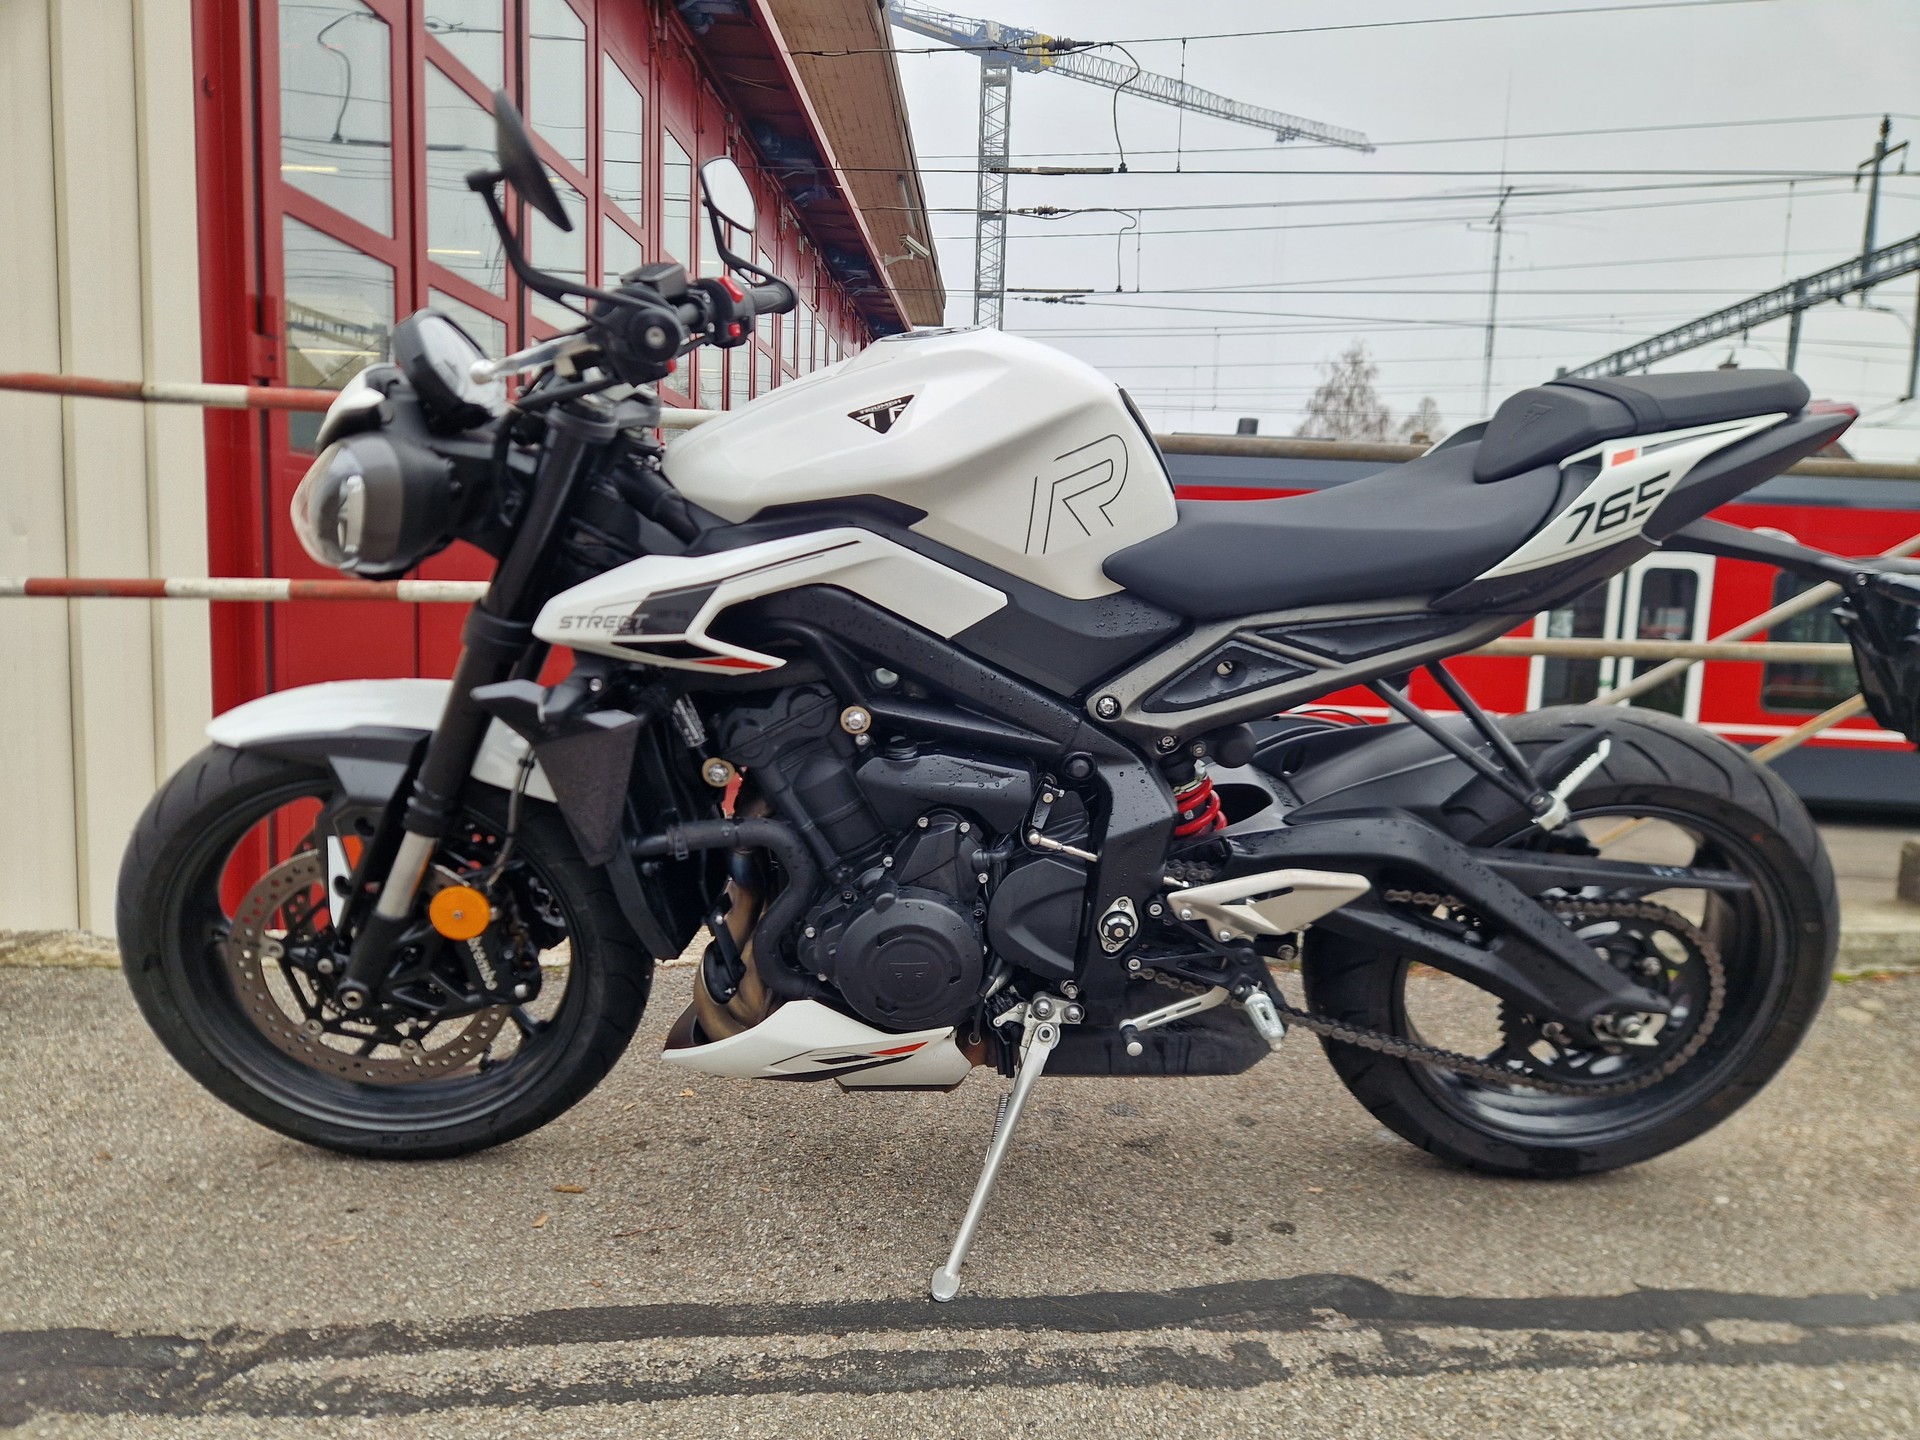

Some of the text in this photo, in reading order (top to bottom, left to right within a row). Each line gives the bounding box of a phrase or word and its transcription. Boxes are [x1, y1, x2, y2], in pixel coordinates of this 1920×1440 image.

[859, 399, 902, 415] TRIUMPH
[1024, 434, 1128, 554] R
[1565, 470, 1671, 544] 765
[558, 613, 650, 630] STREET
[466, 936, 498, 991] brembo
